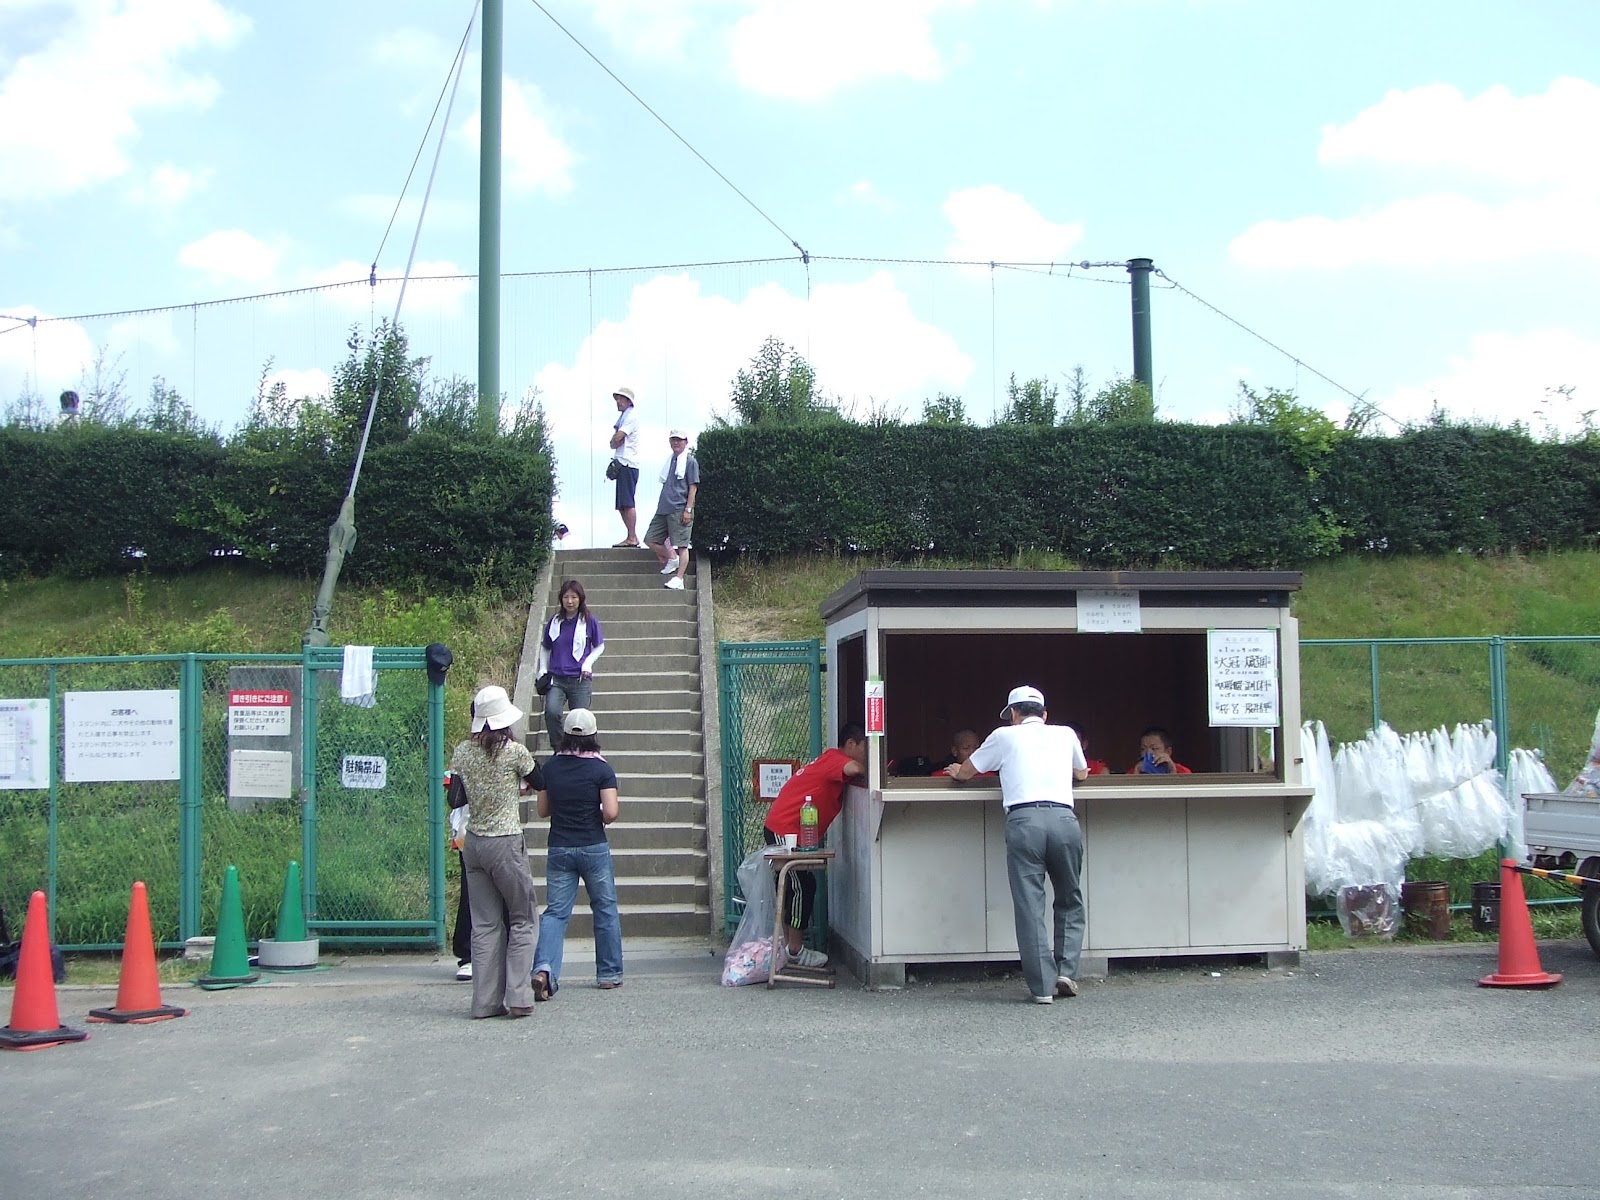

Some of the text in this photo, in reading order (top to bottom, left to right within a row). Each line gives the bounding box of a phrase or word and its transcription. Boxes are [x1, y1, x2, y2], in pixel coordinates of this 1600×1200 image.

[110, 708, 139, 717] お客様へ
[345, 759, 381, 774] 駐輪禁止
